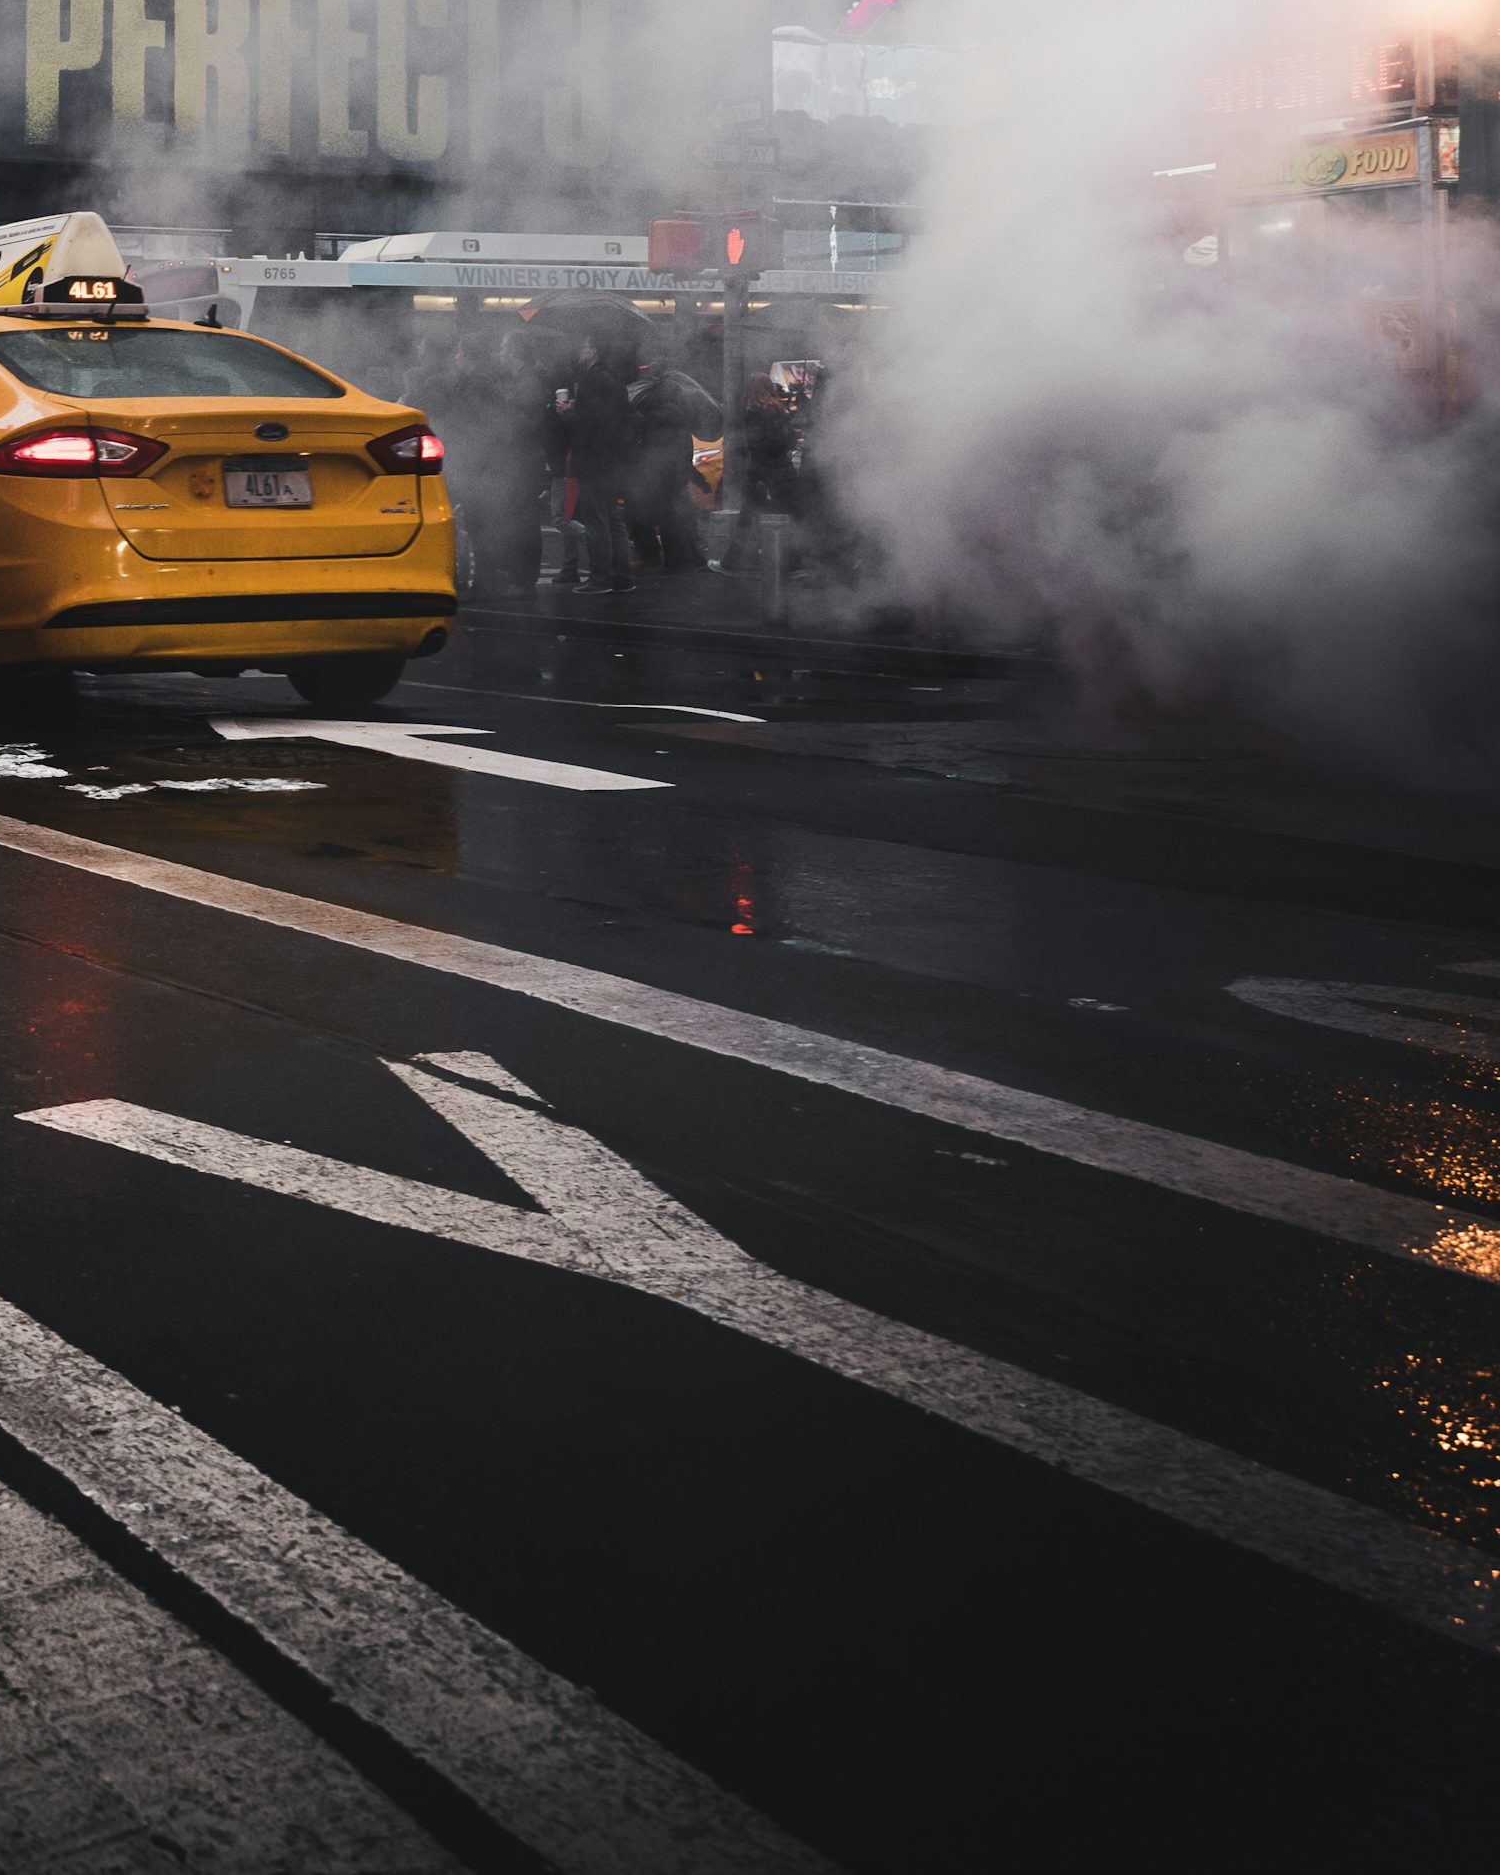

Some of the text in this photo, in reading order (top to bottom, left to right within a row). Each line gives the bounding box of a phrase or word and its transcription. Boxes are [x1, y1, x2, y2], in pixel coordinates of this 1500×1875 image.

[1350, 145, 1411, 176] FOOD
[264, 268, 297, 280] 6765
[455, 267, 541, 287] WINNER
[547, 269, 558, 287] 6
[562, 269, 625, 288] TONY
[69, 281, 117, 299] 4L61
